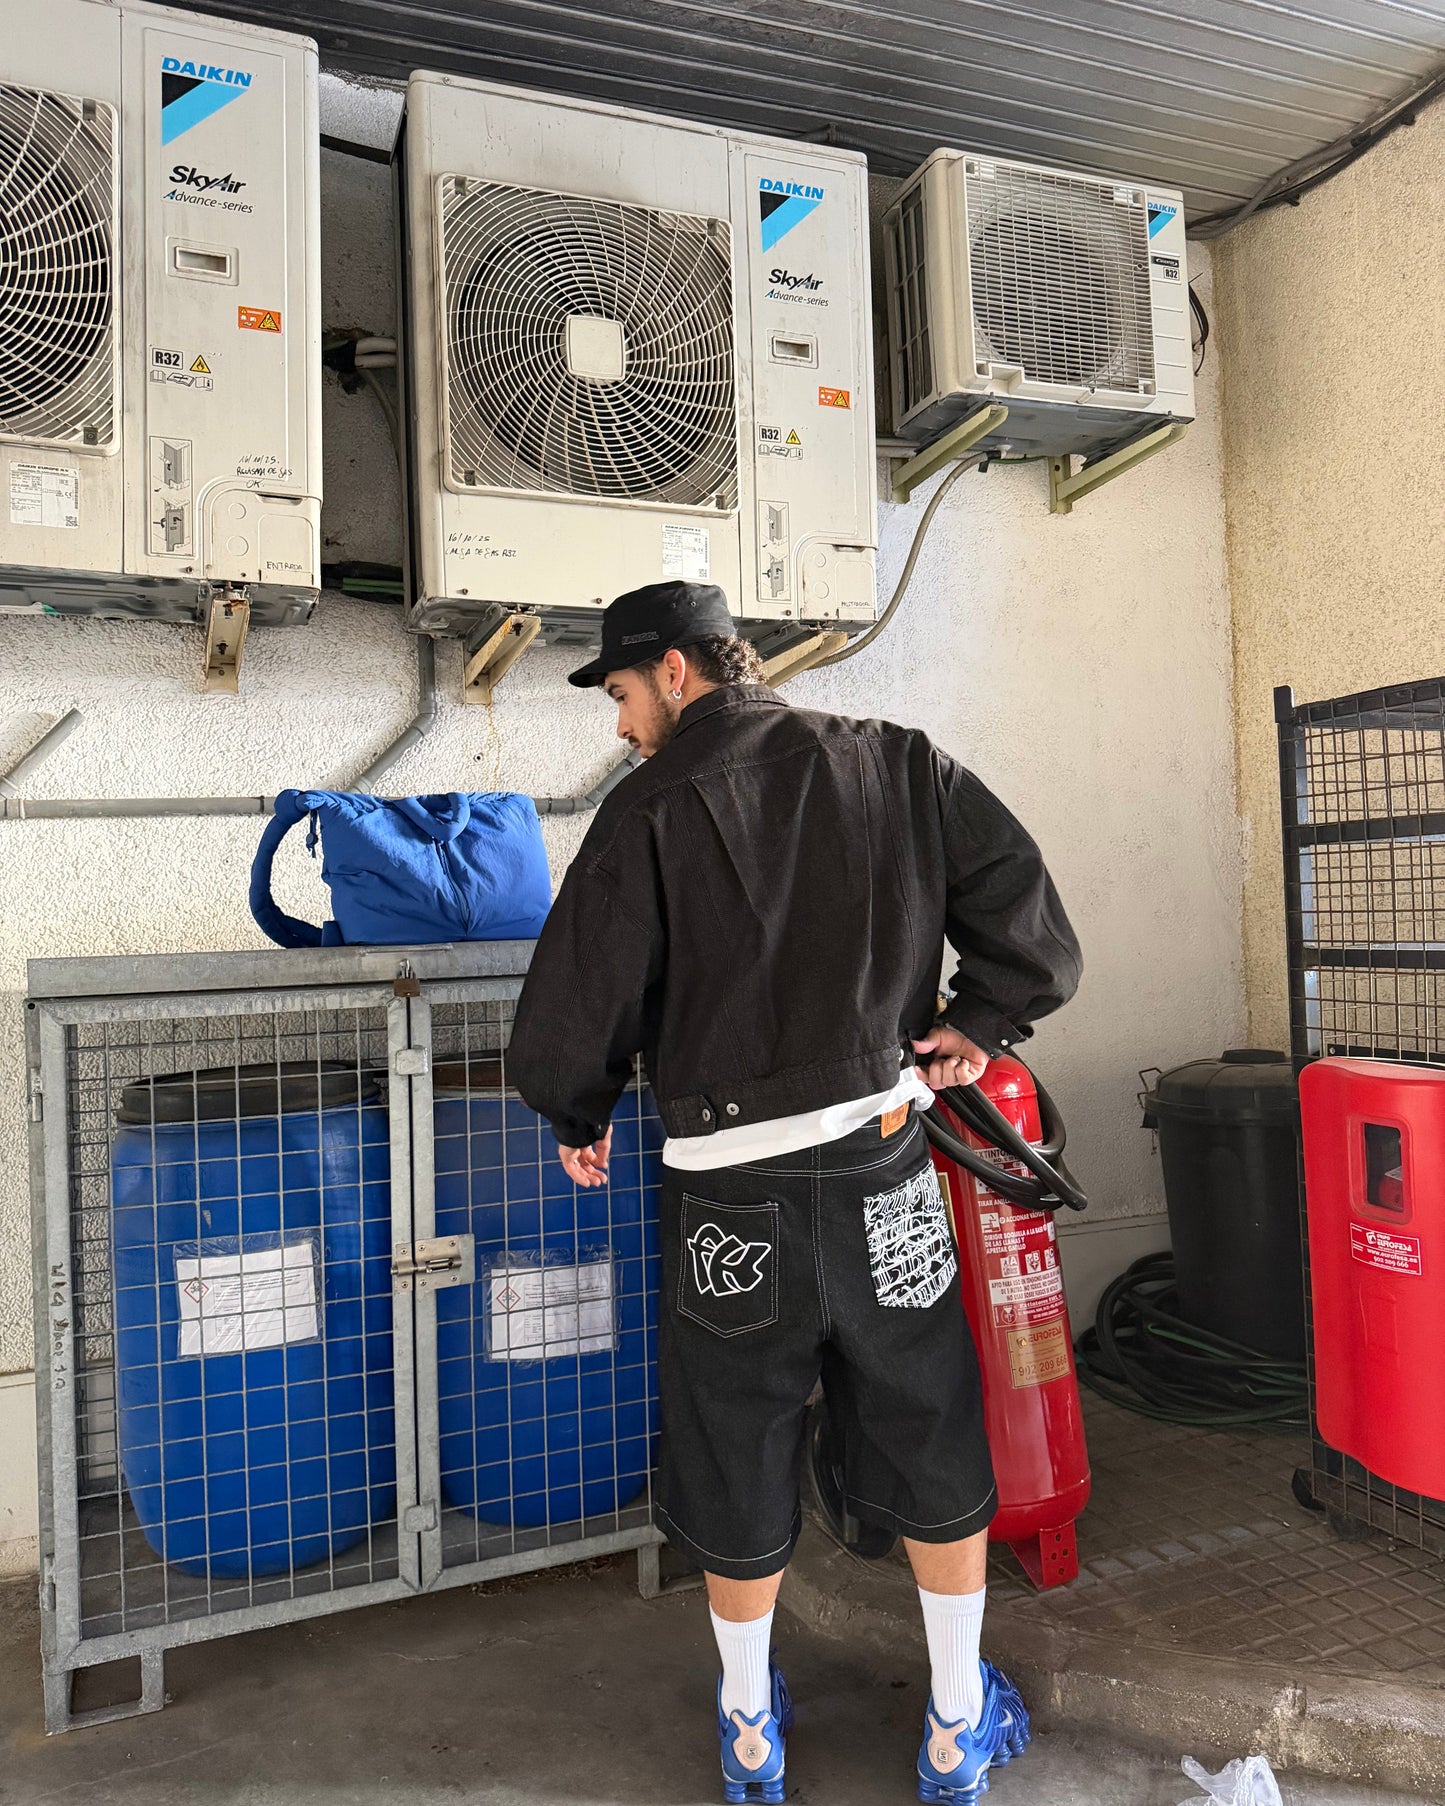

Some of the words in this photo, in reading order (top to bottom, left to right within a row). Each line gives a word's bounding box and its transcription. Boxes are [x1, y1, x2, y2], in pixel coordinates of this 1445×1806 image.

[161, 56, 252, 87] DAIKIN
[169, 165, 246, 194] SkyAir
[759, 178, 825, 200] DAIKIN
[163, 188, 254, 214] Advance-series
[1147, 202, 1178, 214] DAIKIN
[768, 268, 824, 291] SkyAir
[1165, 268, 1178, 279] R32
[765, 289, 830, 307] Advance-series
[155, 351, 180, 367] R32
[761, 428, 779, 440] R32
[266, 561, 303, 570] ENTRADA
[1377, 1239, 1412, 1252] EUROFESA
[1033, 1252, 1040, 1261] B
[1049, 1247, 1055, 1258] C
[1367, 1248, 1418, 1263] www.eurofesa.es
[1010, 1256, 1018, 1266] A
[1040, 1360, 1054, 1372] 209
